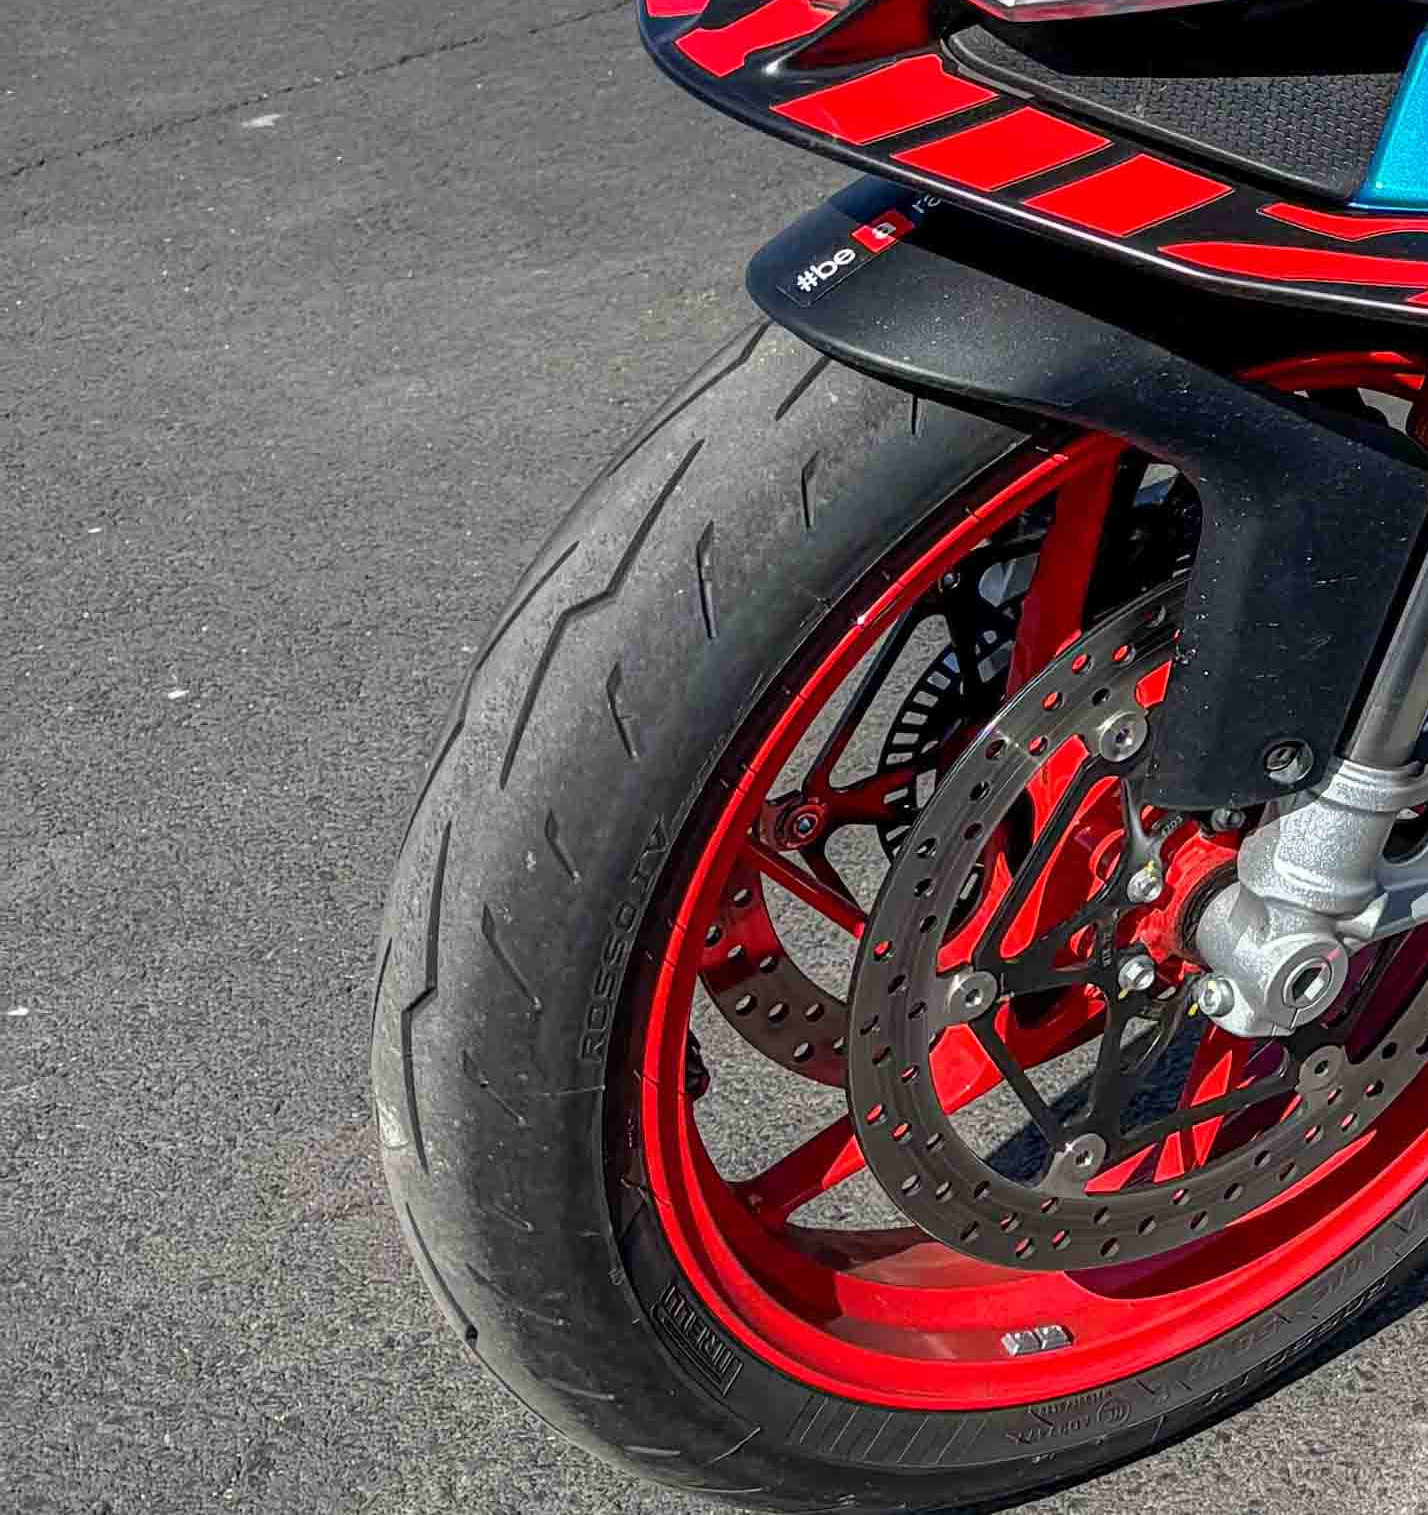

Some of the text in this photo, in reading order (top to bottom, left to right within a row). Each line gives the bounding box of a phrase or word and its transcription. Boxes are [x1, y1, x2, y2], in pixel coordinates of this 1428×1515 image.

[797, 248, 856, 292] #be
[577, 899, 638, 1062] ROSSO
[650, 1278, 744, 1397] PIRELLI
